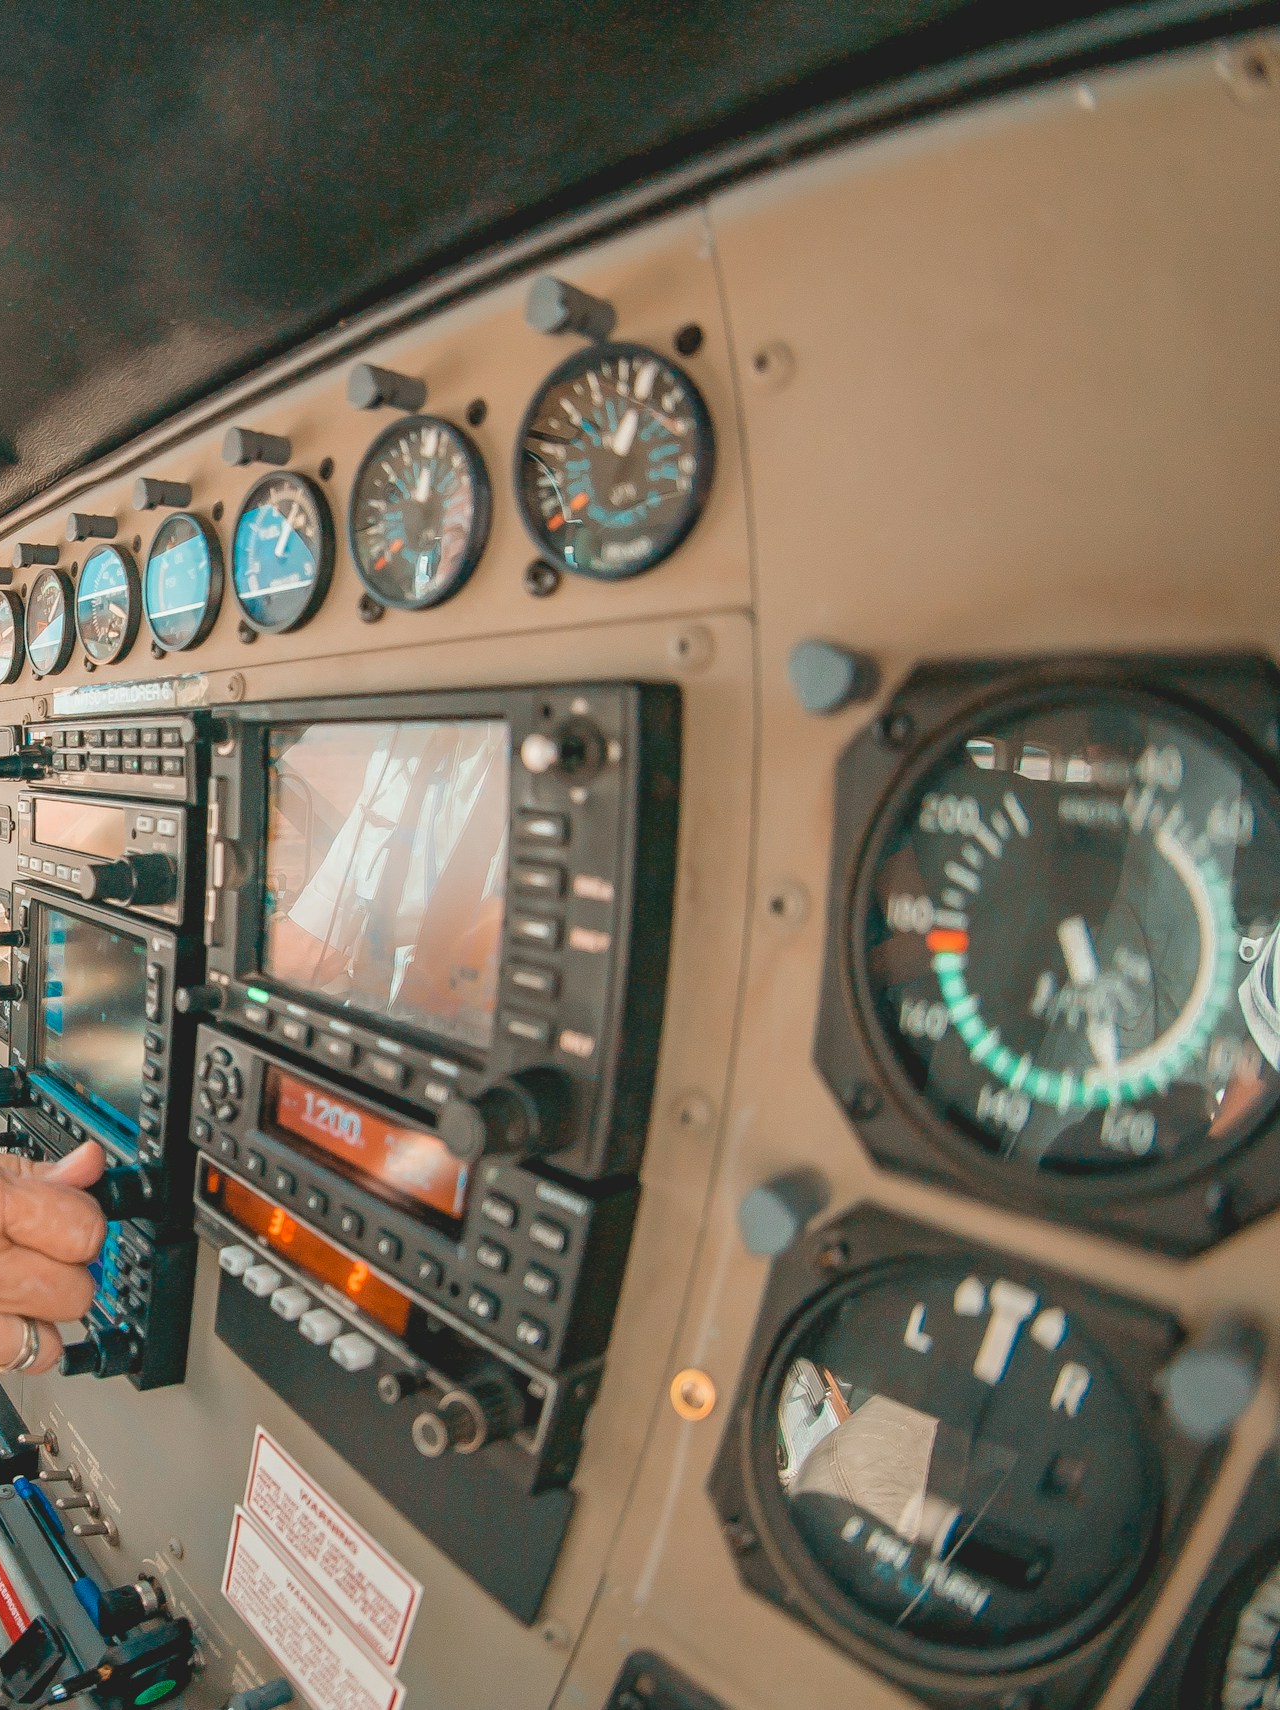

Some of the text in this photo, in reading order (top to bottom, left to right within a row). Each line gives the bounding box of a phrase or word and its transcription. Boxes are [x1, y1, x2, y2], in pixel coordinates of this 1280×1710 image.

[302, 1091, 363, 1146] 1200
[903, 1301, 932, 1354] L
[1050, 1361, 1092, 1418] R
[299, 1488, 359, 1555] WARNING
